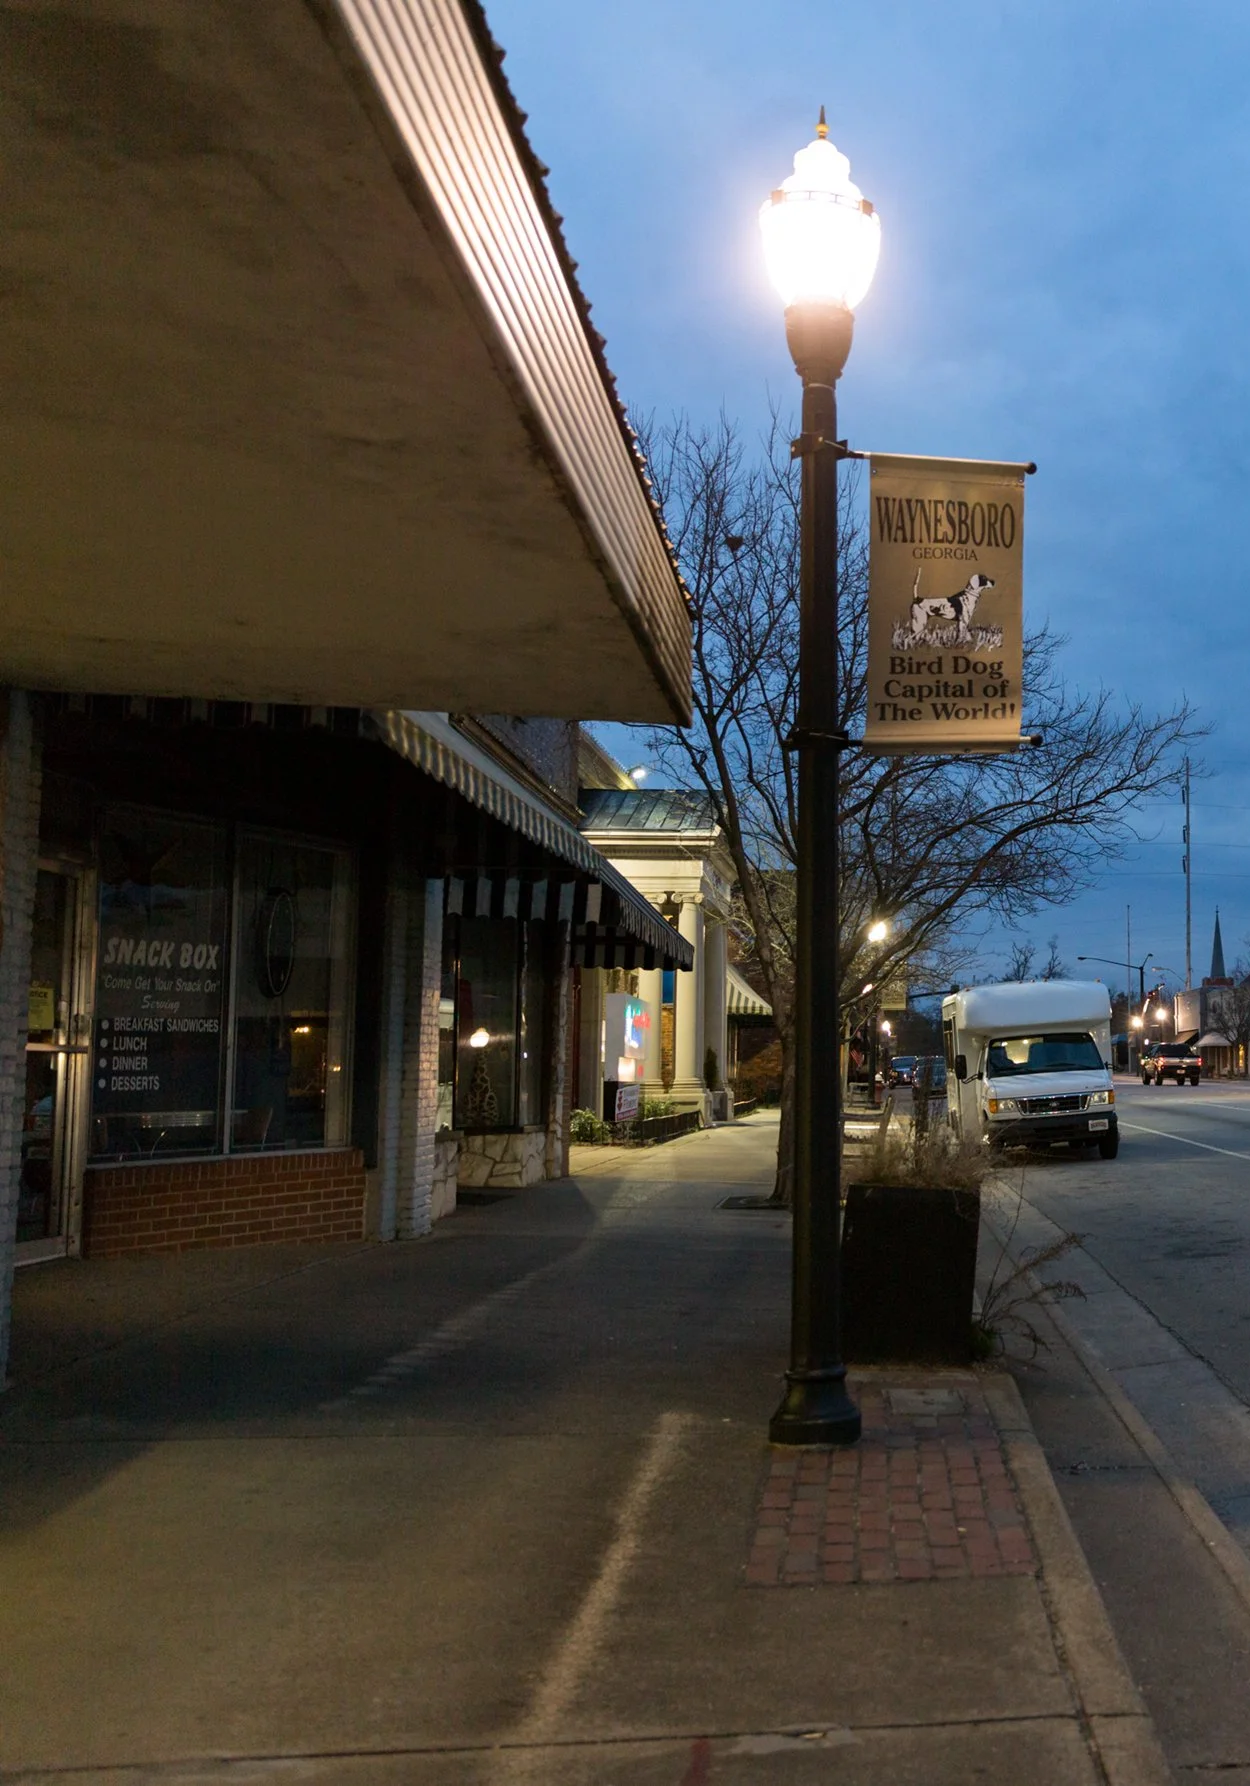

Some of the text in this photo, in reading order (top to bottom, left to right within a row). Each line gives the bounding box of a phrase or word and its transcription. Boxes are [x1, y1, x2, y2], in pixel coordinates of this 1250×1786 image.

[875, 496, 1016, 549] WAYNESBORO
[912, 546, 979, 562] GEORGIA
[888, 655, 1004, 680] Bird Dog
[883, 679, 1010, 703] Capital of
[874, 702, 1016, 722] The World!
[103, 936, 220, 970] SNACK BOX
[134, 975, 151, 991] Get
[154, 976, 174, 991] Your
[175, 977, 202, 993] Snack
[141, 994, 181, 1013] Serving
[113, 1017, 220, 1033] BREAKFAST SANDWICHES
[112, 1036, 148, 1051] LUNCH
[111, 1056, 149, 1071] DINNER
[110, 1075, 161, 1091] DESSERTS
